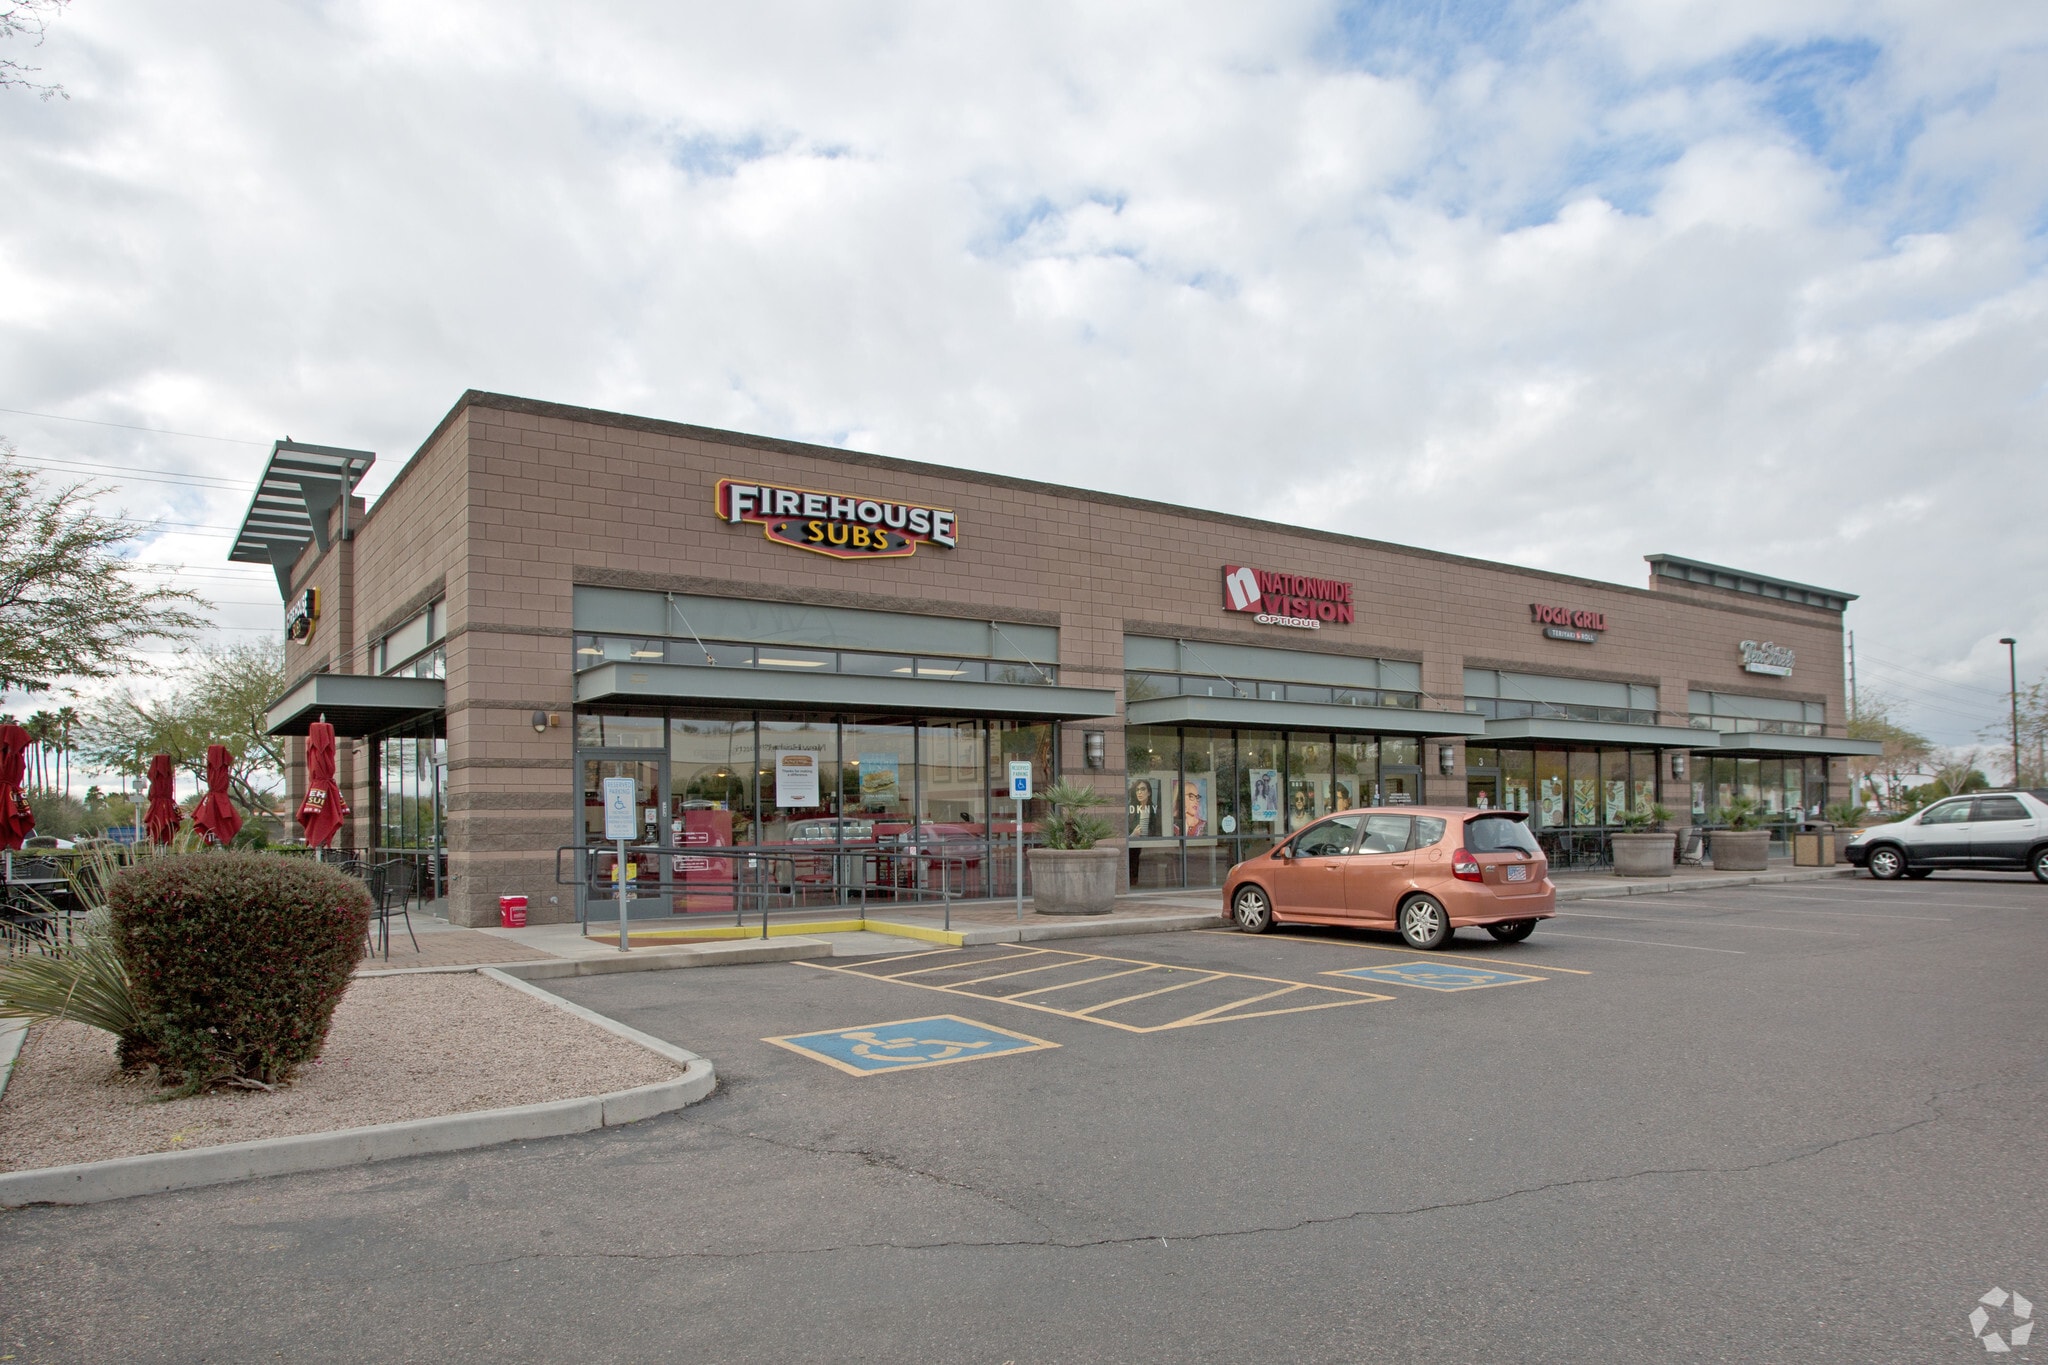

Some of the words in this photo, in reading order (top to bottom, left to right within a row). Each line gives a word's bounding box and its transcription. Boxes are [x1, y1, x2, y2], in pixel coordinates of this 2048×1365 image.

[728, 483, 956, 548] FIREHOUSE
[808, 520, 888, 550] SUBS
[1260, 571, 1354, 604] NATIONWIDE
[1262, 594, 1355, 624] VISION
[1573, 609, 1609, 631] GRILL
[1258, 614, 1320, 629] OPTIQUE
[1398, 754, 1403, 764] 2
[1479, 757, 1484, 767] 3
[1129, 804, 1158, 814] DKNY
